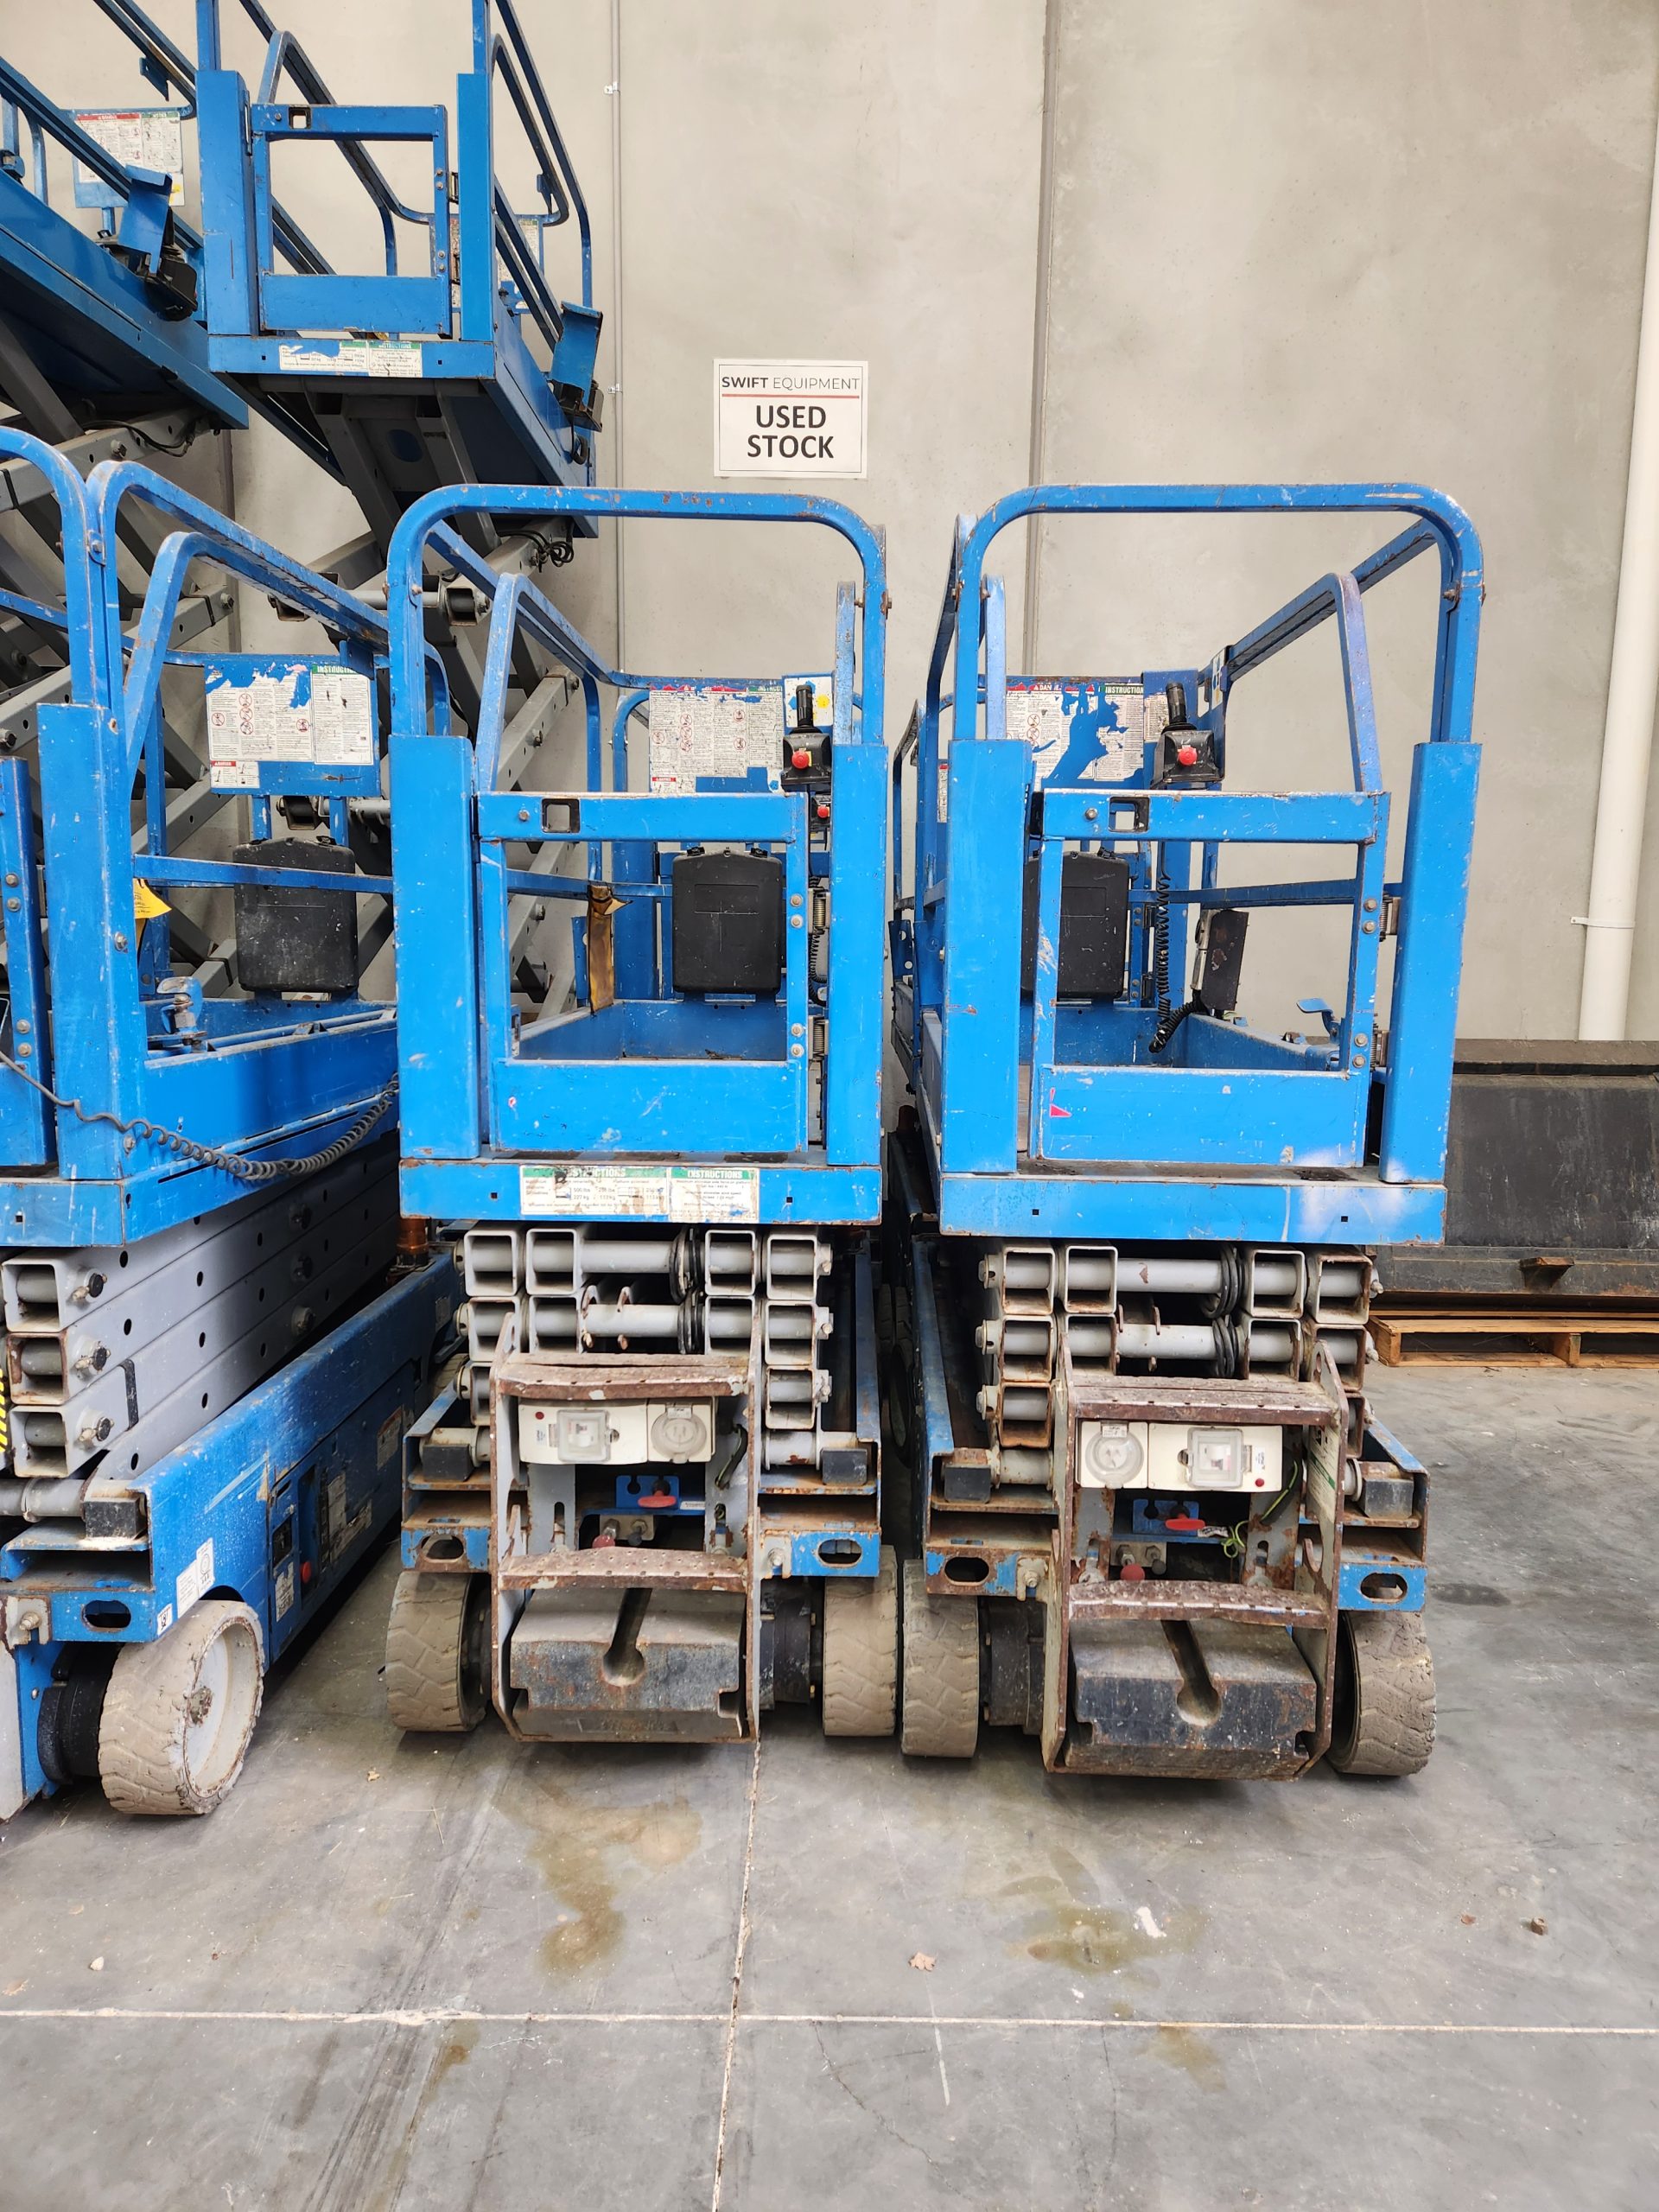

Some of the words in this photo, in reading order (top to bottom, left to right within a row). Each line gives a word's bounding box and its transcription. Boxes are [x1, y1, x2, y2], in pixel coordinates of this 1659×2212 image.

[721, 377, 768, 388] SWIFT
[773, 378, 860, 391] EQUIPMENT
[756, 405, 826, 429] USED
[747, 435, 834, 458] STOCK
[687, 1170, 743, 1179] INSTRUCTIONS
